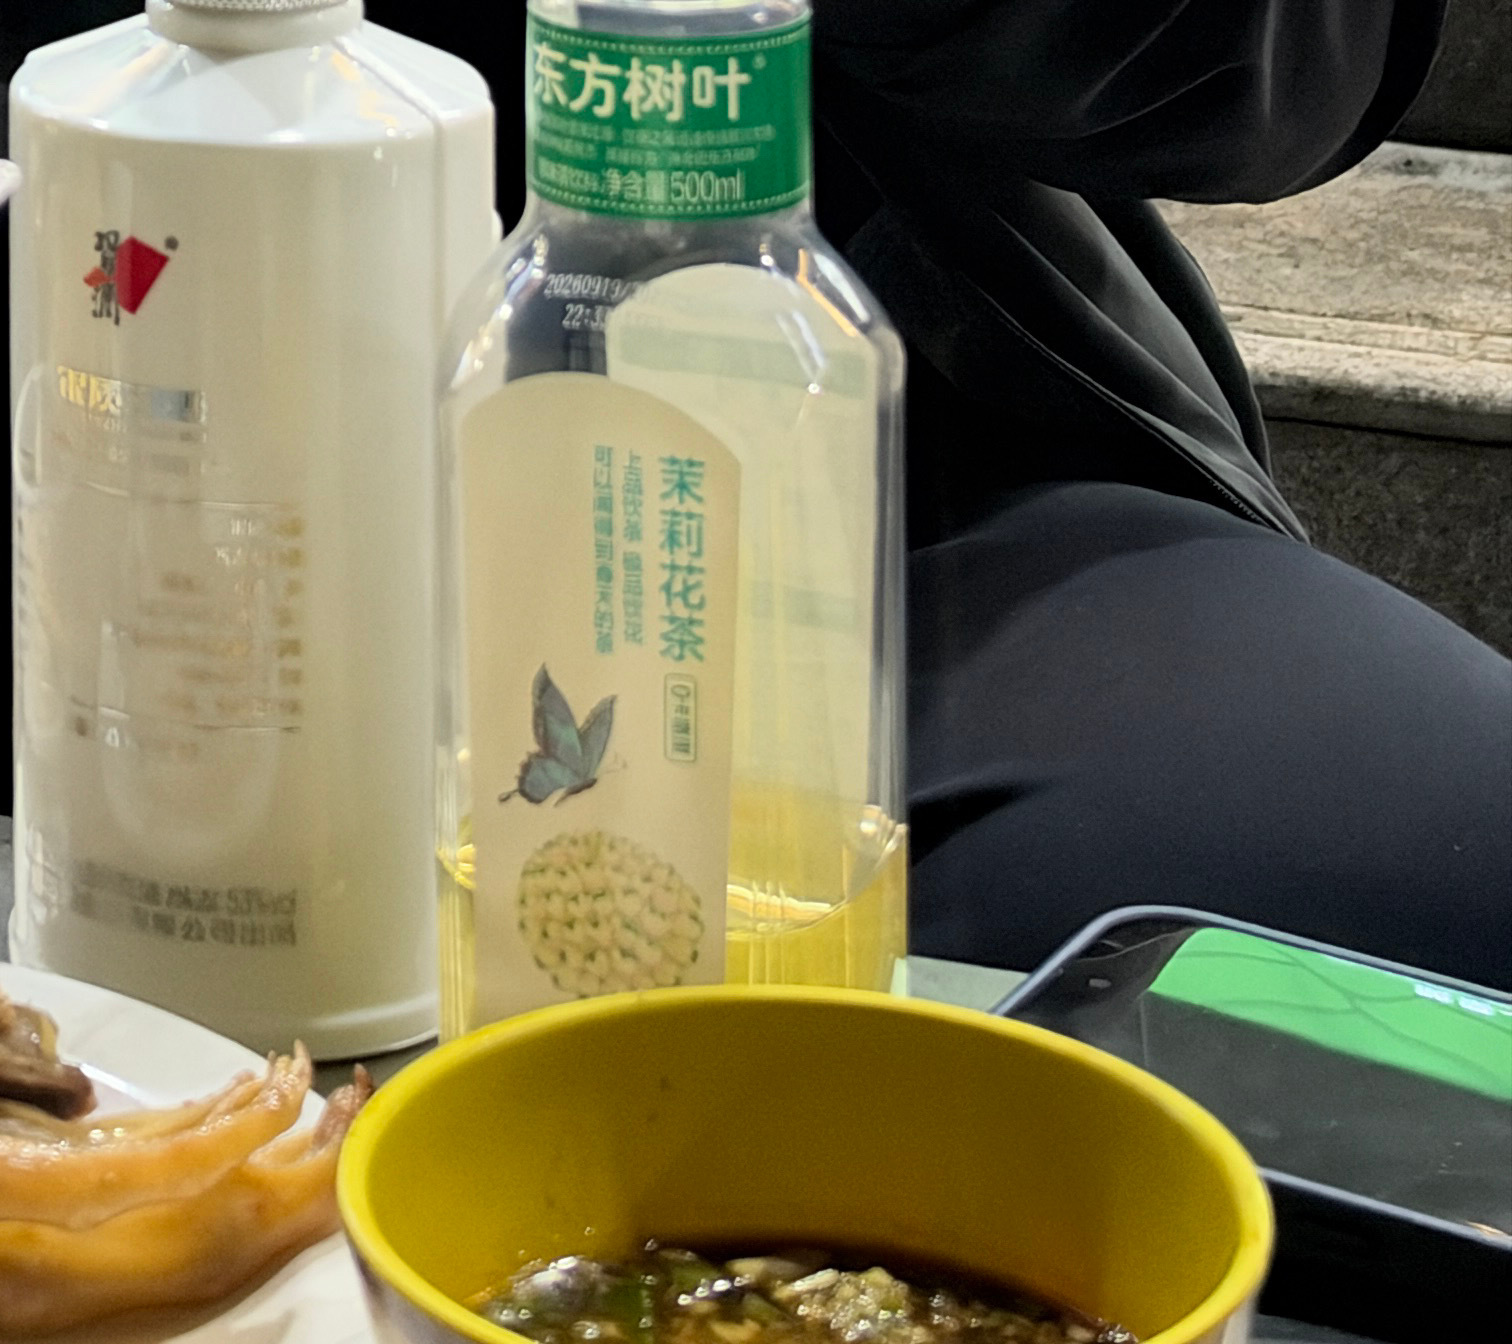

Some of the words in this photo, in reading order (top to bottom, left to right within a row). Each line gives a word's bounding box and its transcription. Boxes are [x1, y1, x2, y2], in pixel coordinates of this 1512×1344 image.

[533, 42, 751, 122] 东方树叶
[658, 454, 707, 662] 茉莉花茶
